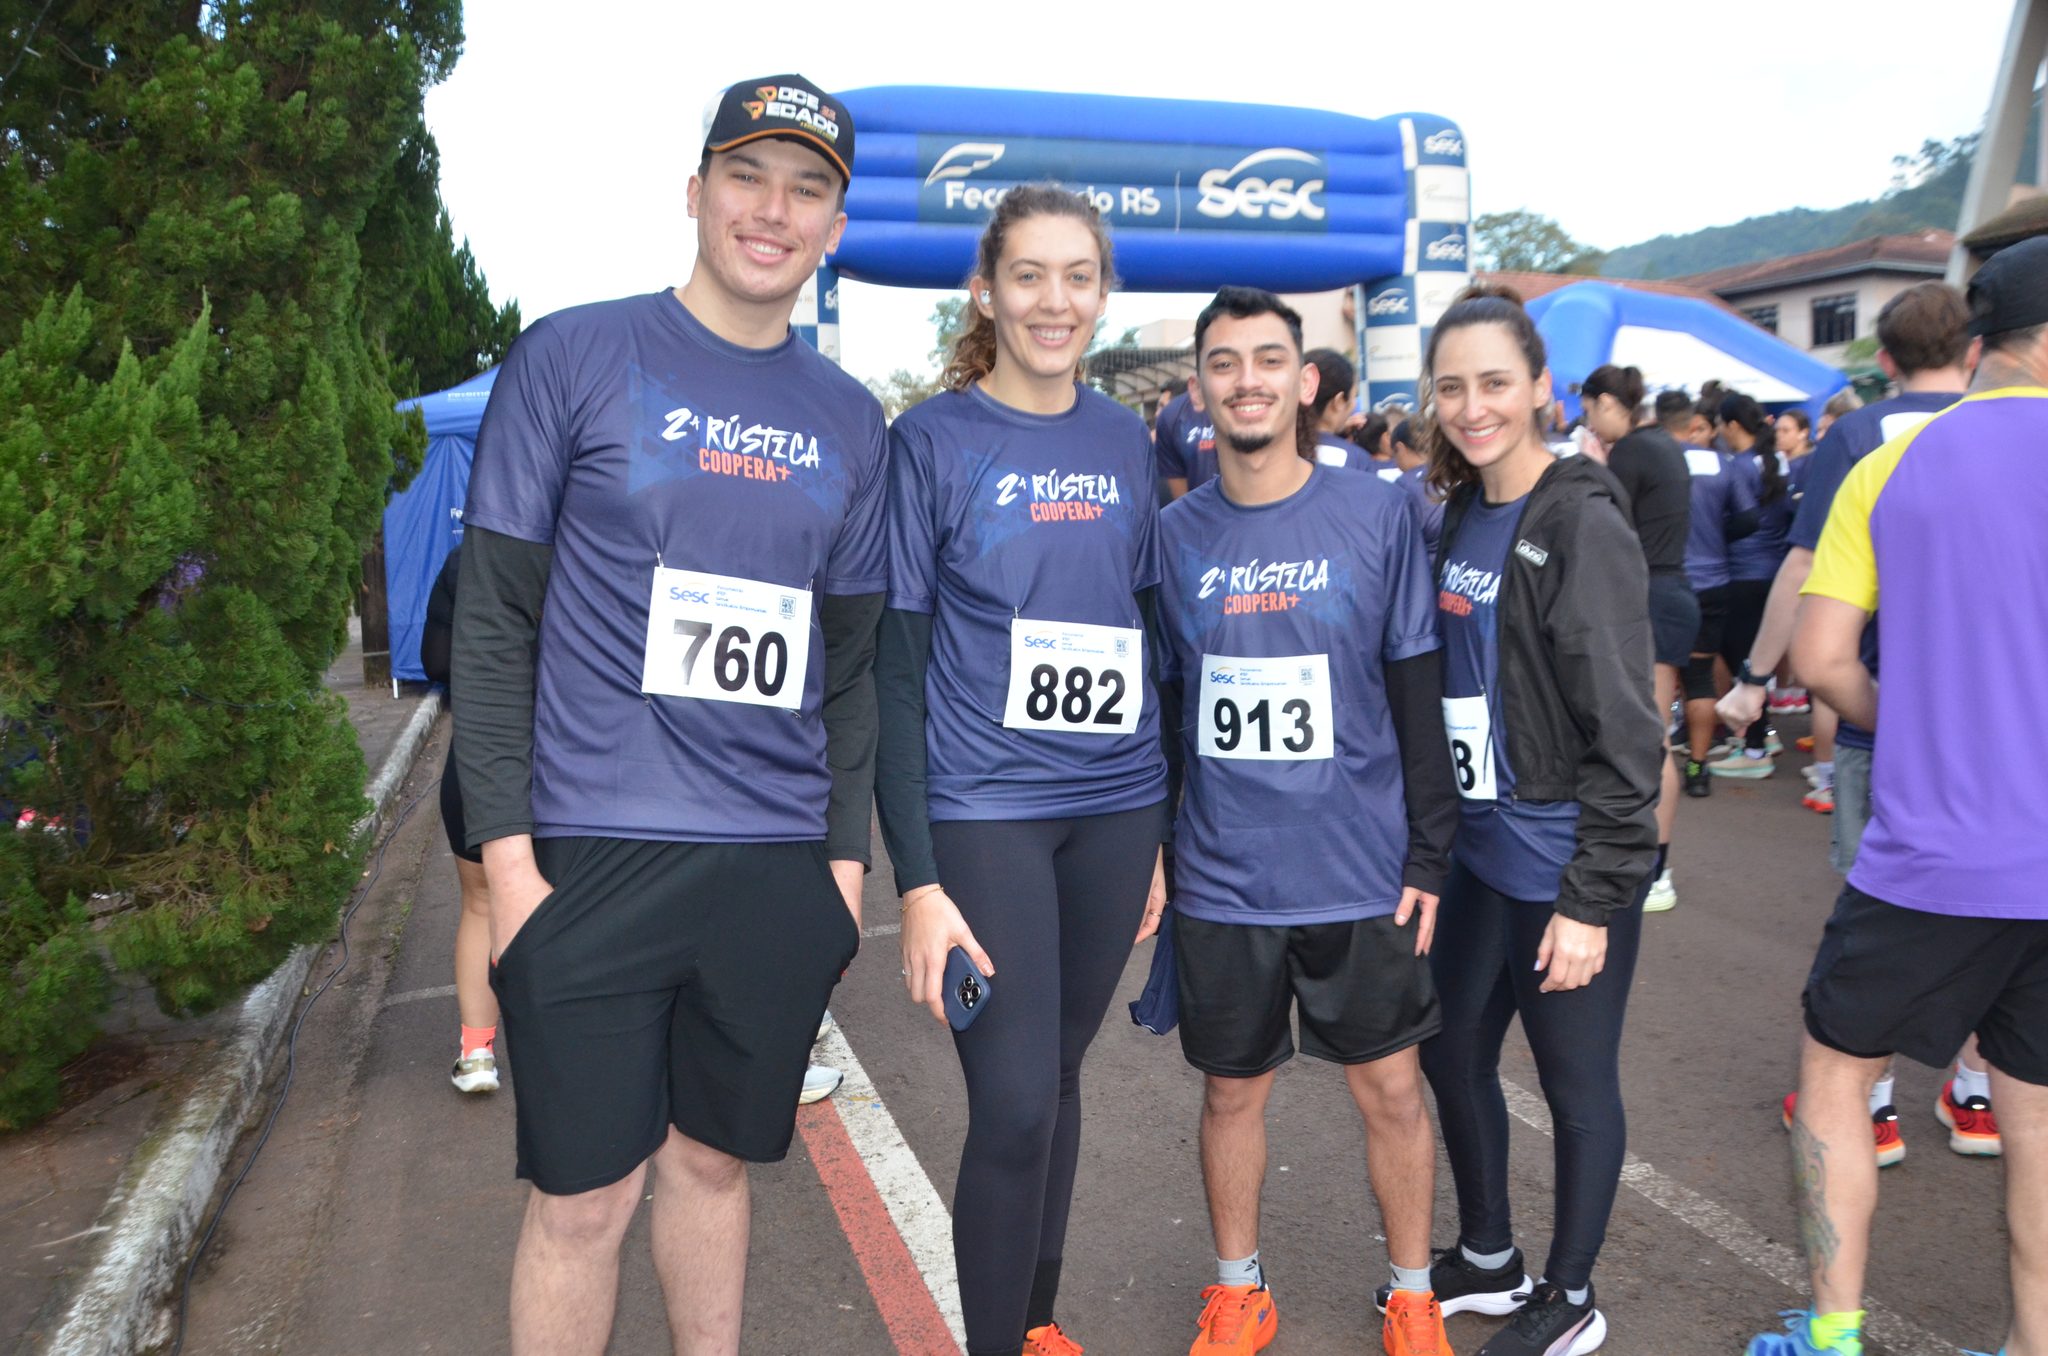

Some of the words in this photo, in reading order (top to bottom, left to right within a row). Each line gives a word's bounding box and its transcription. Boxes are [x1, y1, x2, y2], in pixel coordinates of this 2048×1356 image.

[742, 101, 839, 139] PECADO
[1121, 186, 1161, 216] RS
[706, 414, 821, 469] RÚSTICA
[699, 447, 793, 482] COOPERA+
[1031, 468, 1120, 504] RÚSTICA
[1030, 501, 1104, 522] COOPERA+
[1229, 558, 1329, 596] RÚSTICA
[1224, 591, 1302, 615] COOPERA+
[673, 618, 788, 697] 760
[1026, 663, 1126, 726] 882
[1213, 697, 1315, 752] 913
